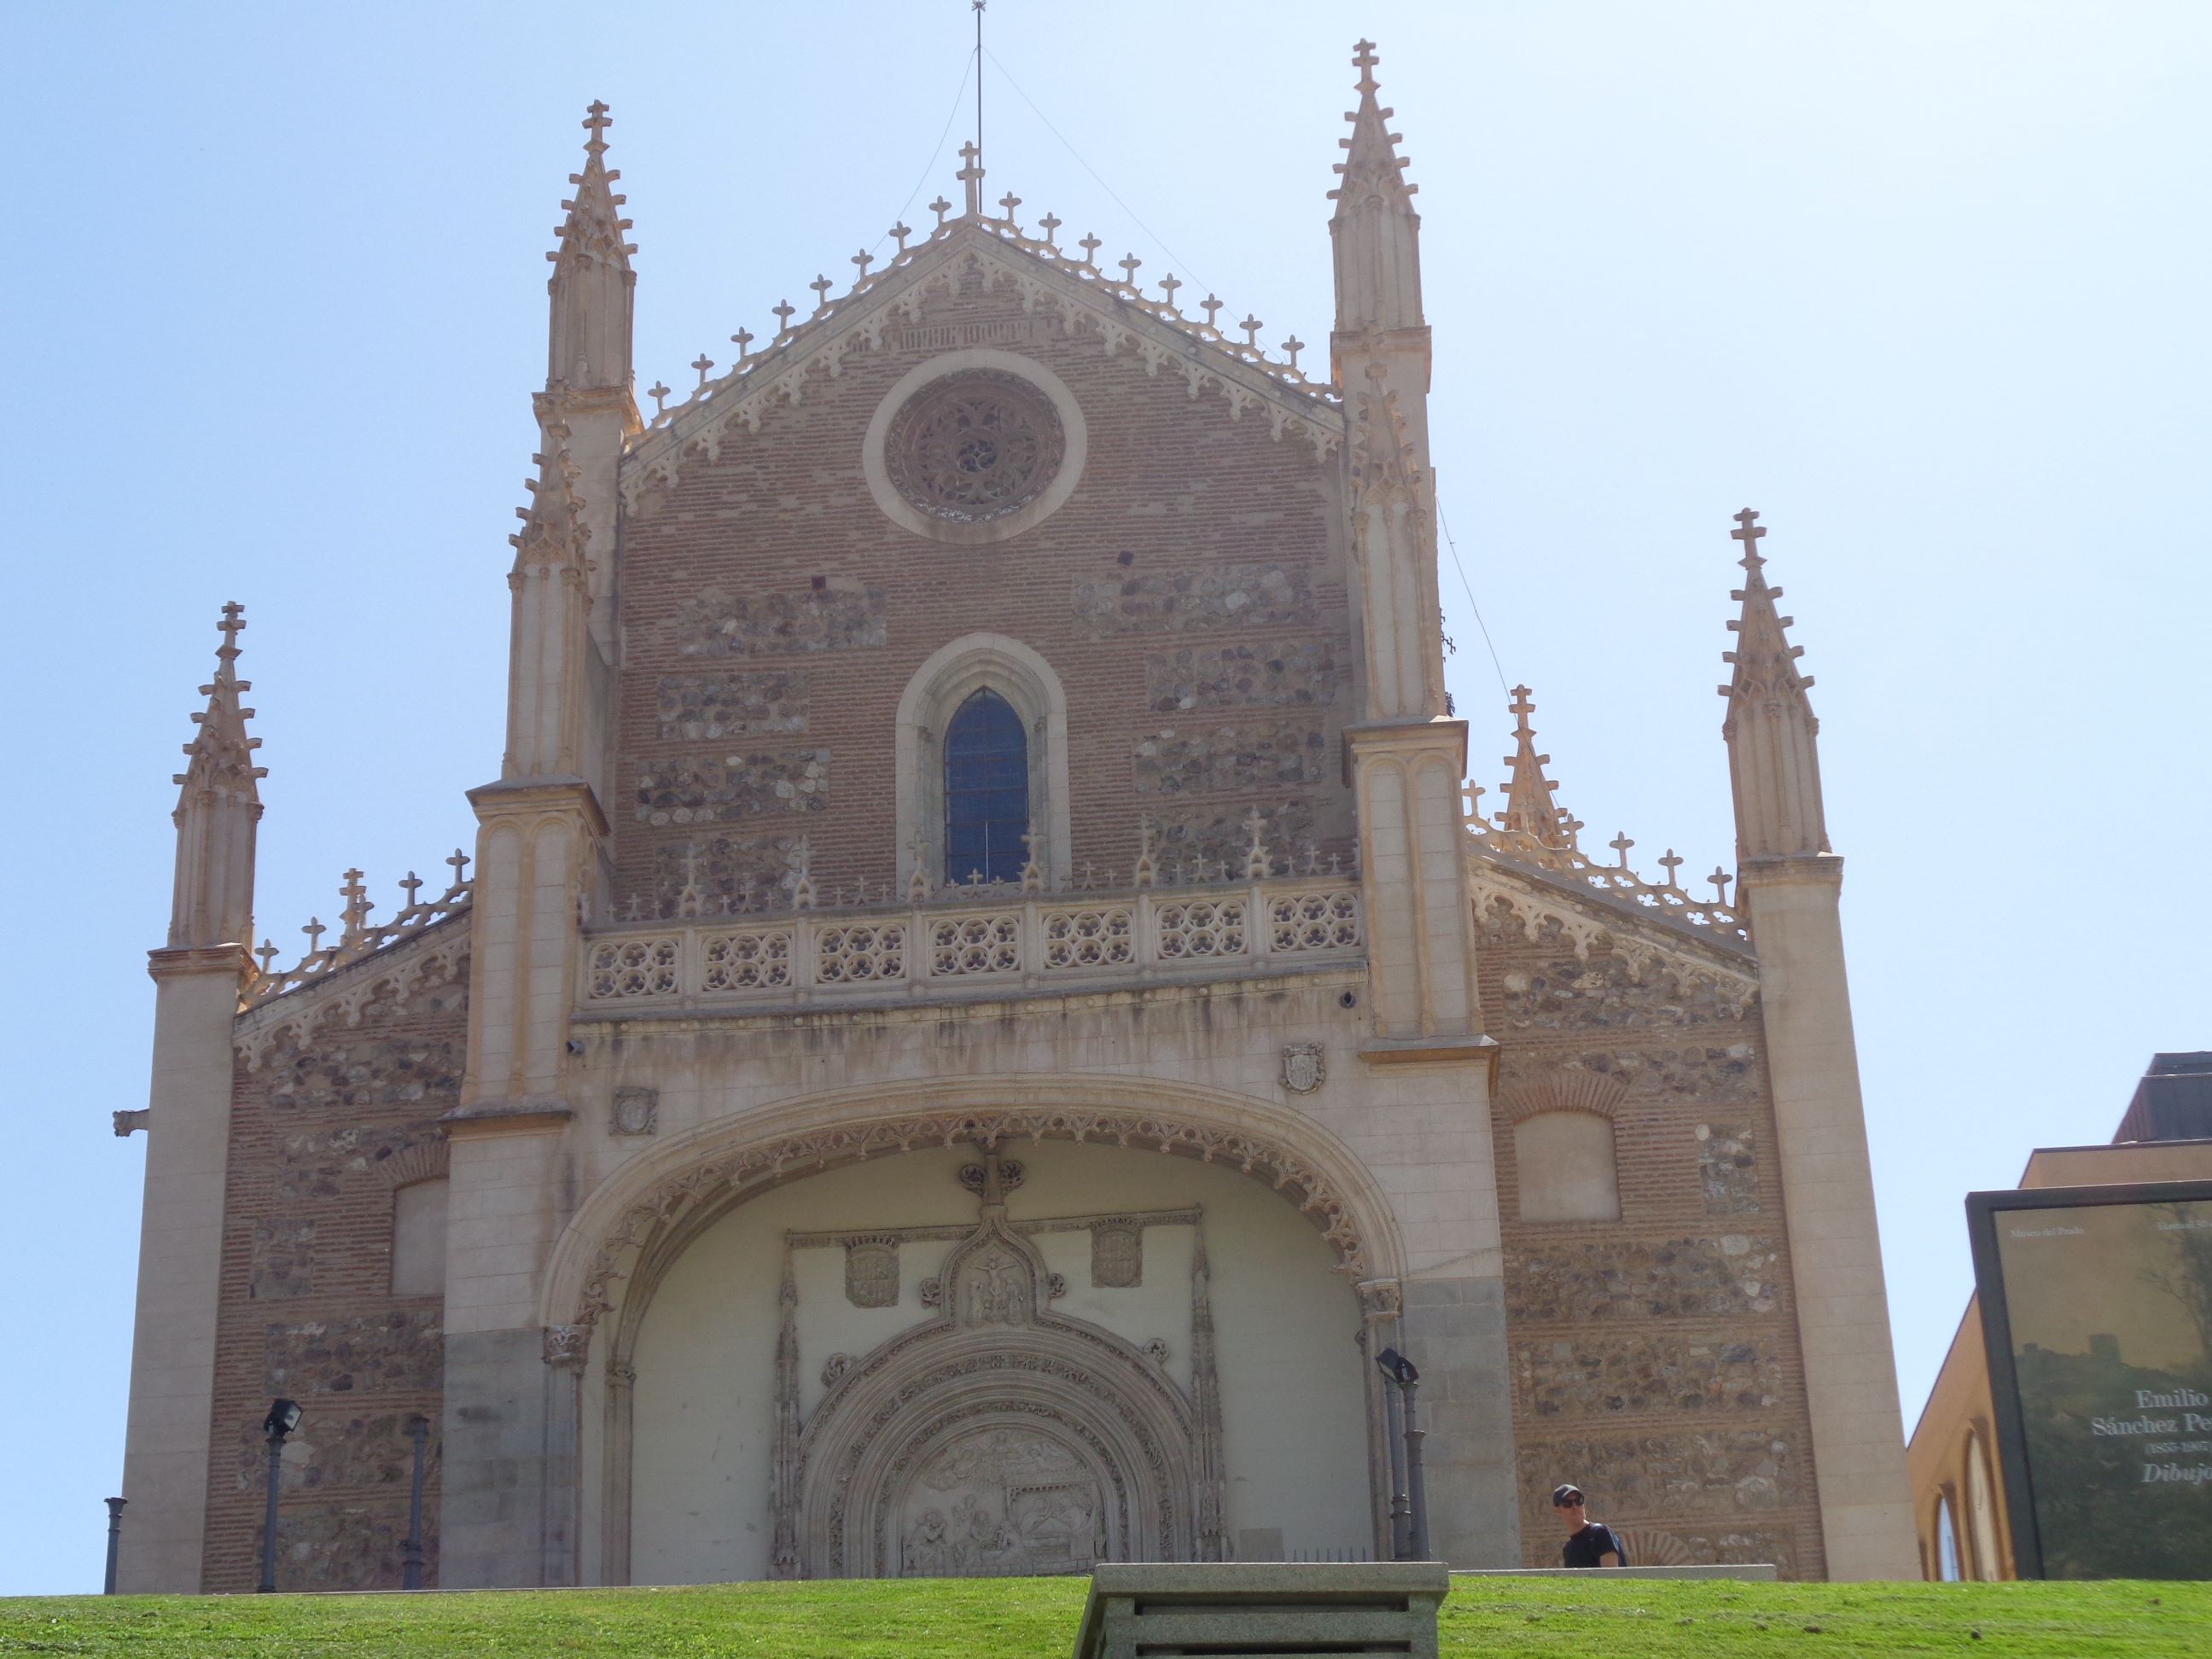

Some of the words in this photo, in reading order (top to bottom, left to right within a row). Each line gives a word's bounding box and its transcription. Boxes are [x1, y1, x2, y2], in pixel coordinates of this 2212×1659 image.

[2009, 1228, 2040, 1237] Museo
[2042, 1227, 2056, 1236] del
[2058, 1226, 2084, 1236] Prado
[2134, 1388, 2209, 1408] Emilio
[2092, 1415, 2178, 1436] Sánchez
[2183, 1412, 2212, 1432] Pe
